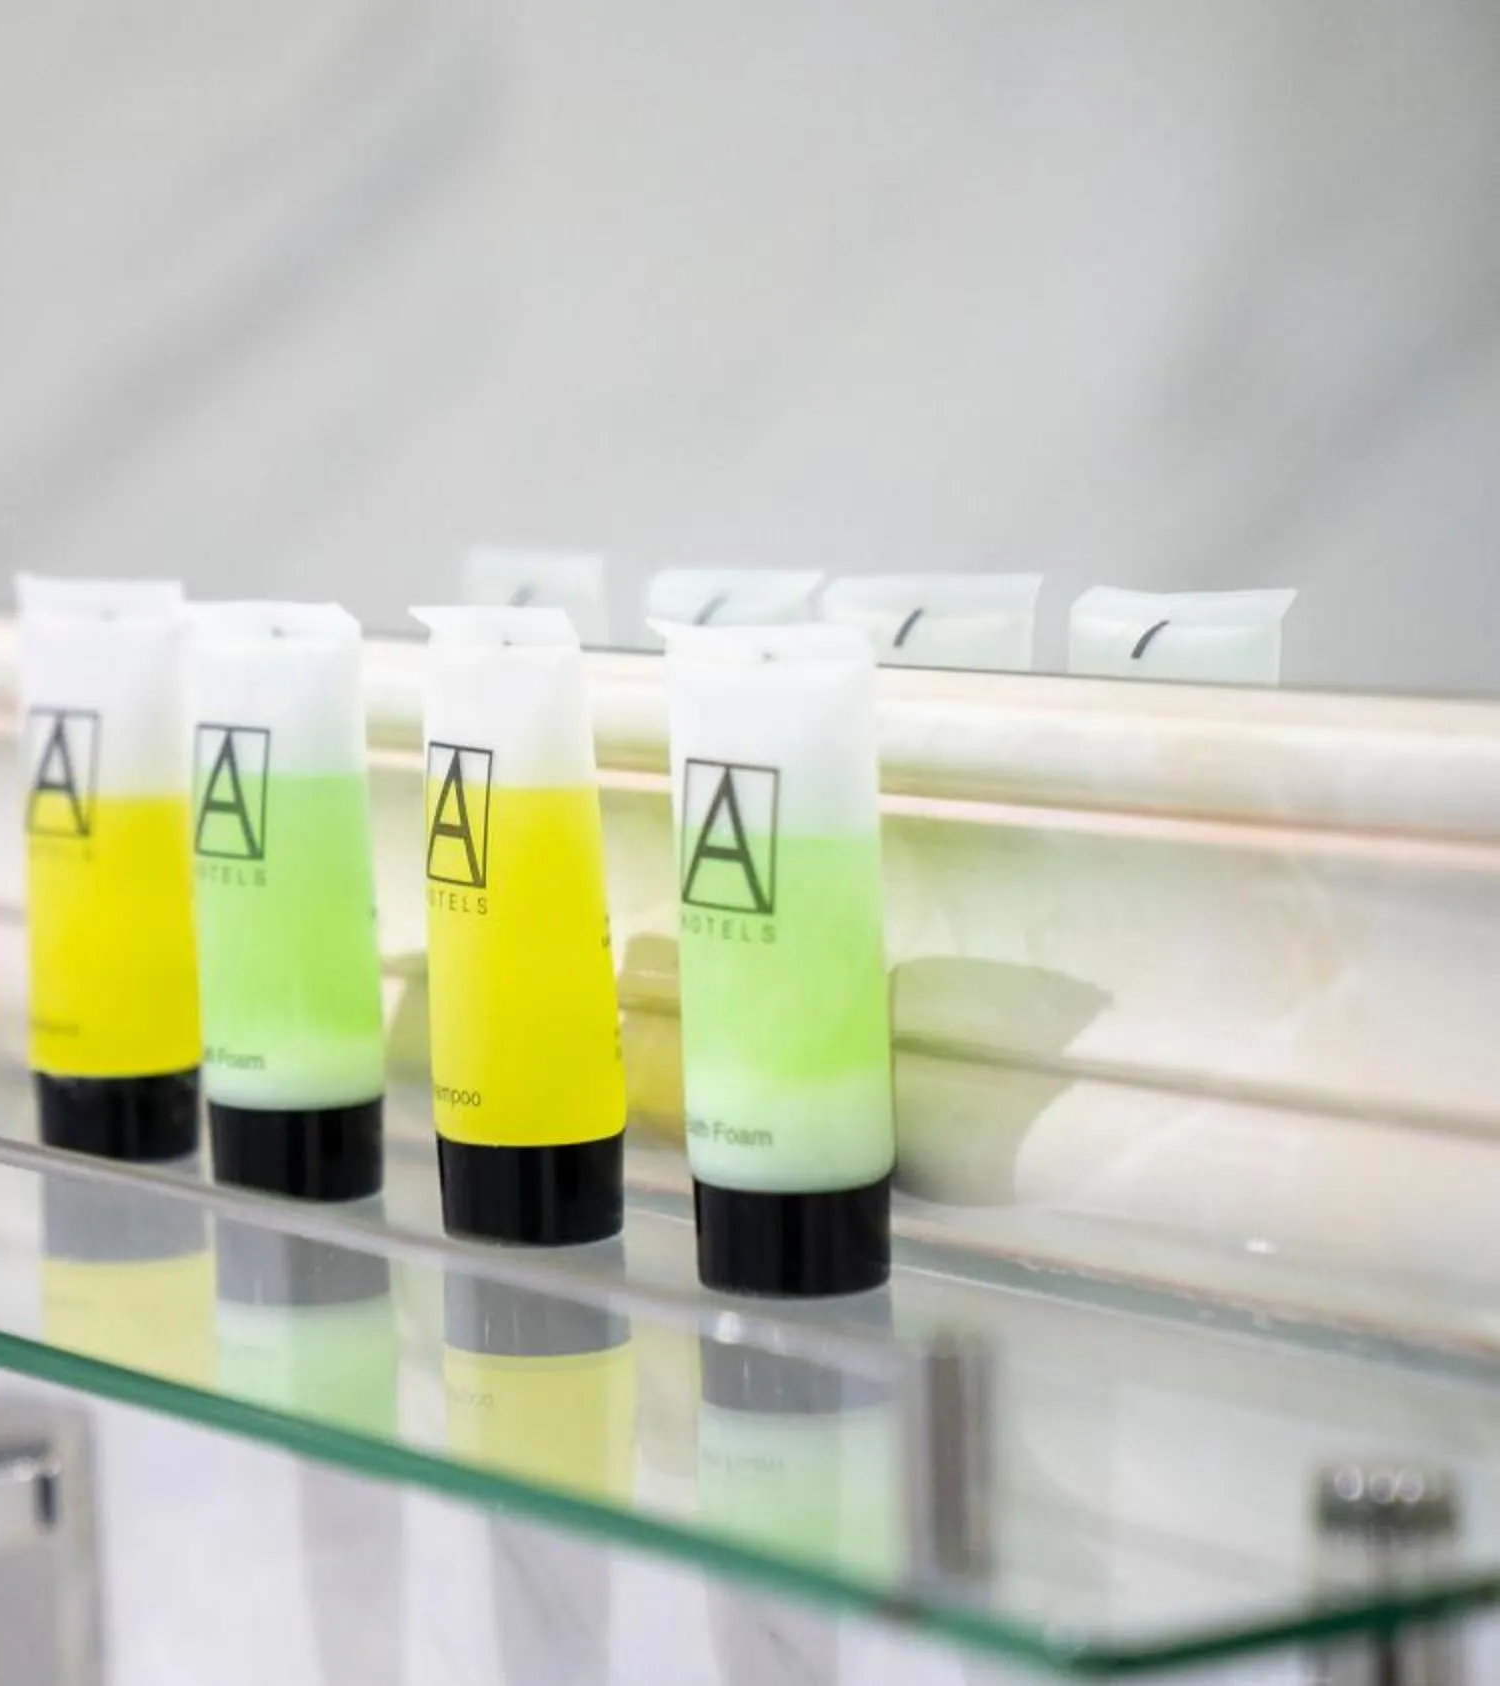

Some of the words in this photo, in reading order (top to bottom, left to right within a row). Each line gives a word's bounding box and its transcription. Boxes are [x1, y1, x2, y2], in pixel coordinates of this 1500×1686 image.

[26, 709, 92, 836] A
[195, 726, 266, 860] A
[426, 745, 488, 888] A
[426, 888, 488, 915] OTELS
[681, 763, 776, 914] A
[712, 1120, 774, 1148] Foam
